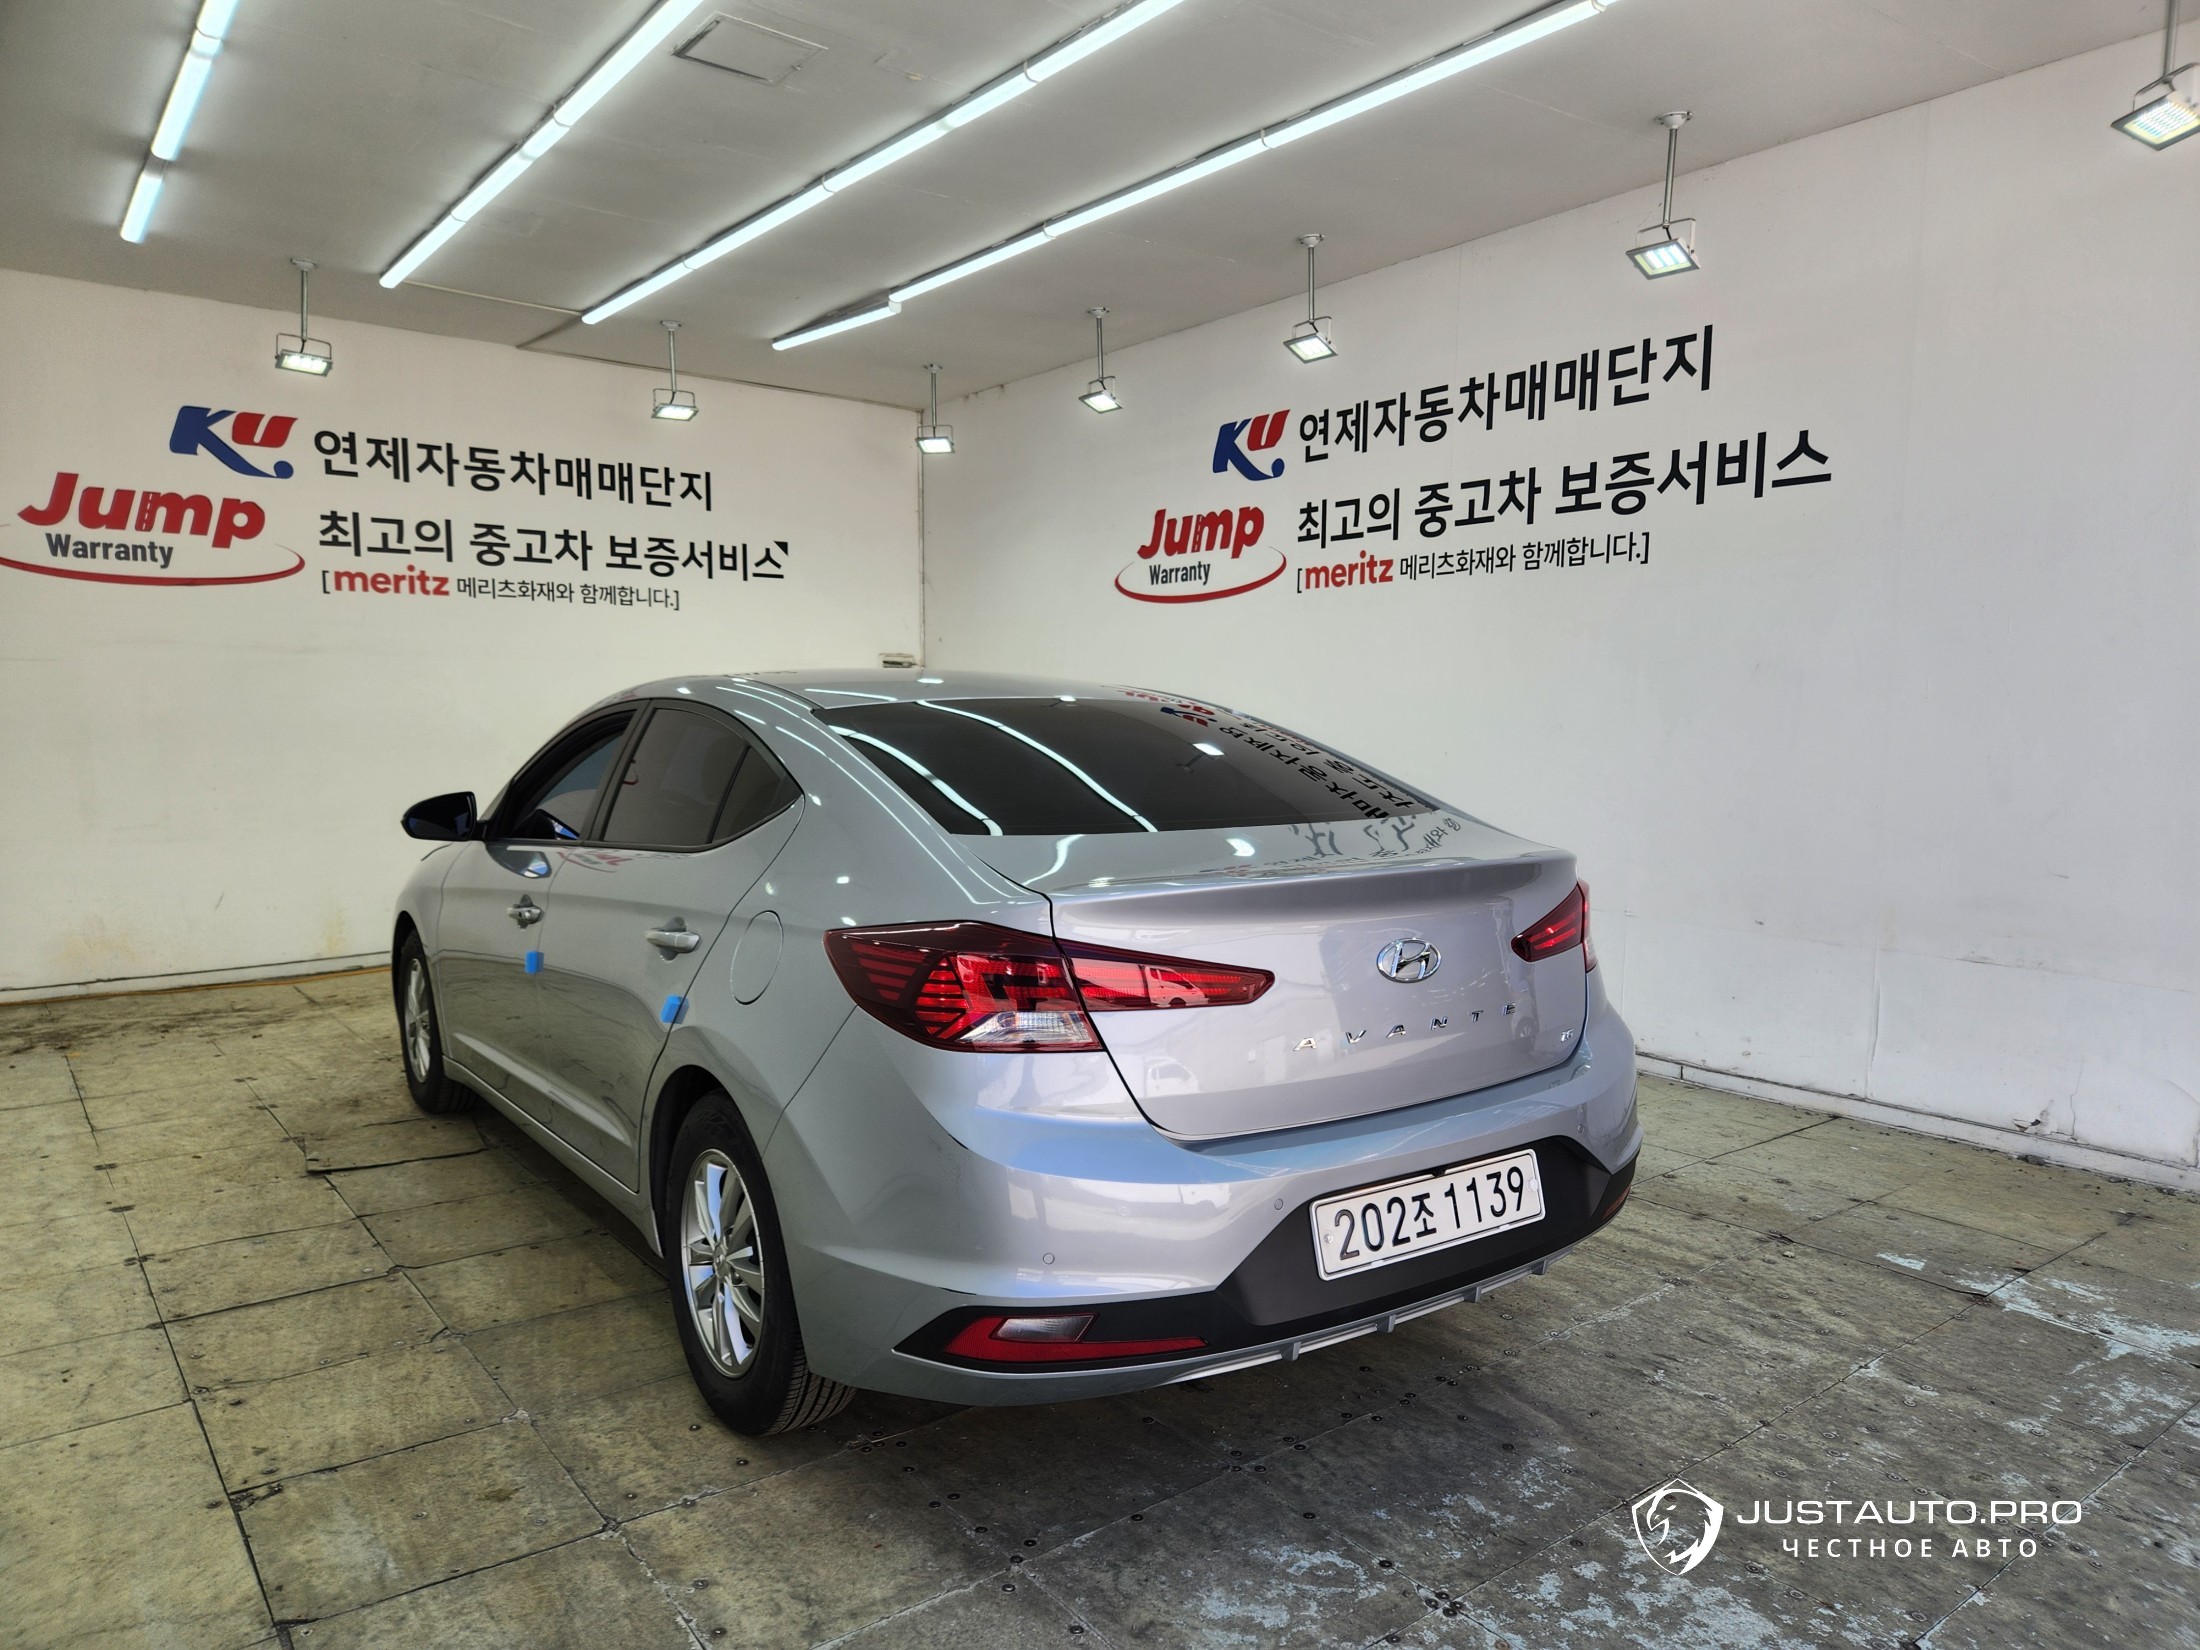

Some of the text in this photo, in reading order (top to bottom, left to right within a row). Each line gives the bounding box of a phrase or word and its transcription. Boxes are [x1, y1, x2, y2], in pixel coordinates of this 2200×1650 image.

[1299, 324, 1713, 463] 연제자동차매매단지
[314, 430, 712, 511] 연제자동차매매단지
[1297, 430, 1831, 549] 최고의 중고차 보증서비스
[17, 472, 265, 548] Jump
[1137, 506, 1264, 559] Jump
[45, 533, 173, 569] Warranty
[319, 510, 784, 581] 최고의 중고차 보증서비스
[1400, 545, 1516, 581] 메리츠화재와
[456, 577, 575, 603] 메리츠화재와
[1149, 561, 1210, 585] Warranty
[1293, 1002, 1517, 1051] AVANTE
